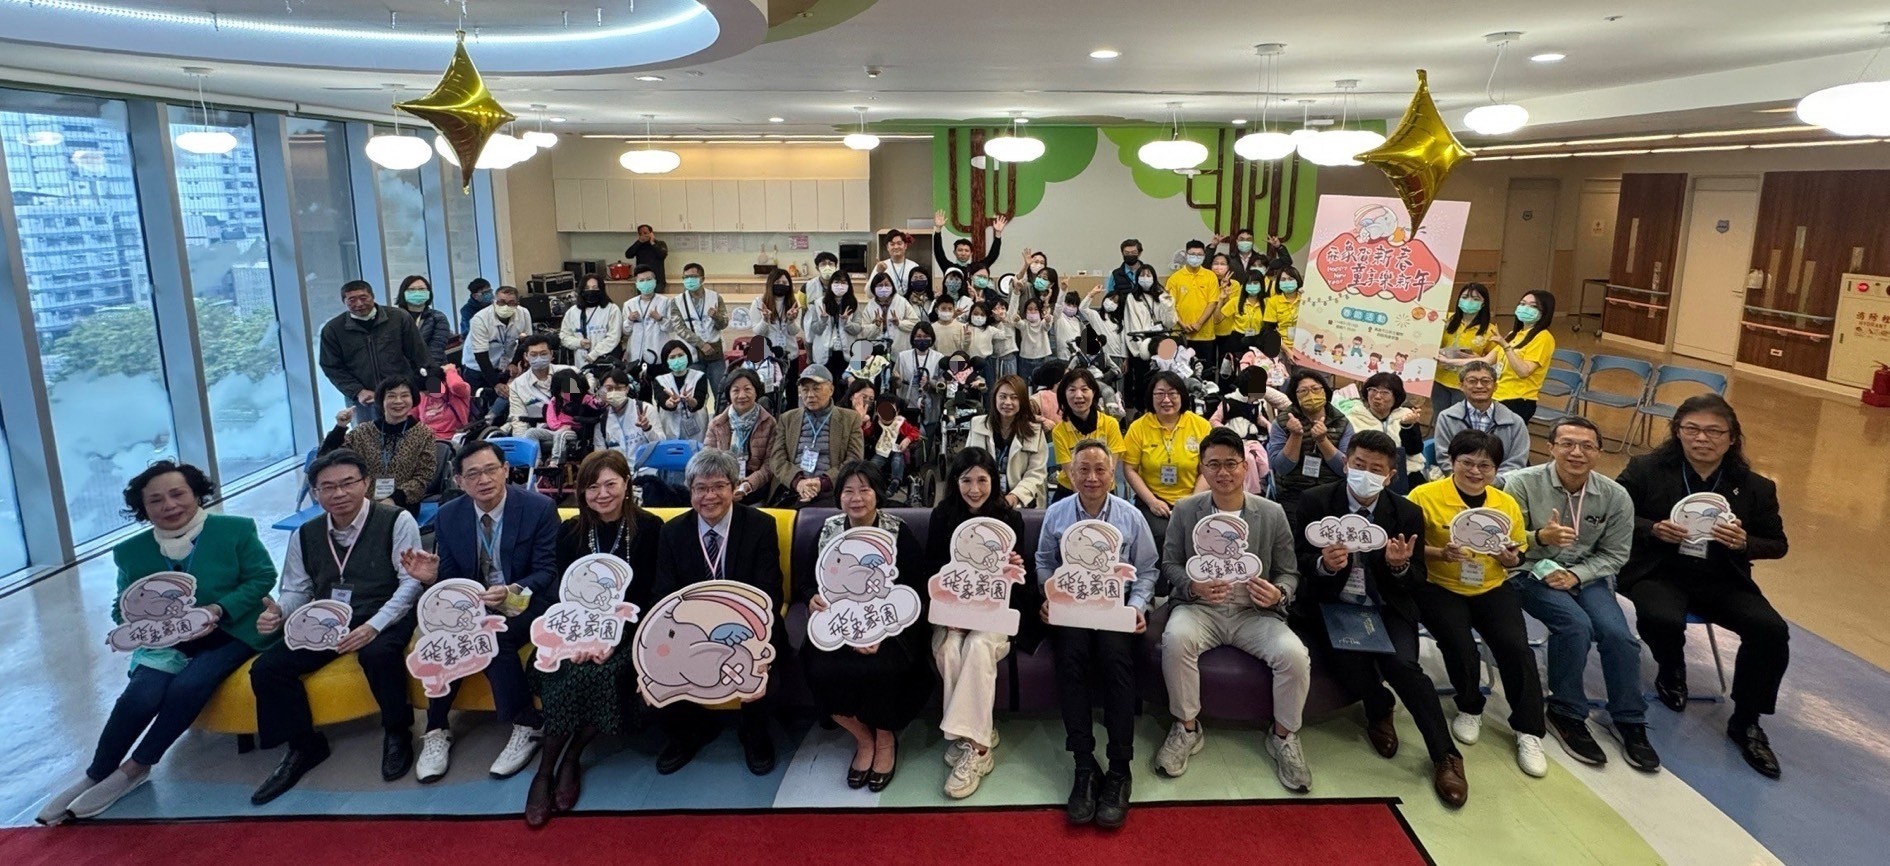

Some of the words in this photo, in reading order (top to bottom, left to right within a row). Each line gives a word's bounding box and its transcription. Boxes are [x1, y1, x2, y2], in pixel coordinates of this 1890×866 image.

[1326, 240, 1413, 271] 飛象賀新春
[1347, 263, 1435, 302] 童享樂新年
[1200, 558, 1248, 578] 飛象家園
[941, 568, 1007, 601] 飛象家園
[1056, 569, 1120, 601] 飛象家園
[128, 617, 193, 644] 飛象家園
[545, 609, 619, 644] 飛象家園
[828, 603, 899, 641] 飛象家園
[420, 634, 493, 666] 飛象家園
